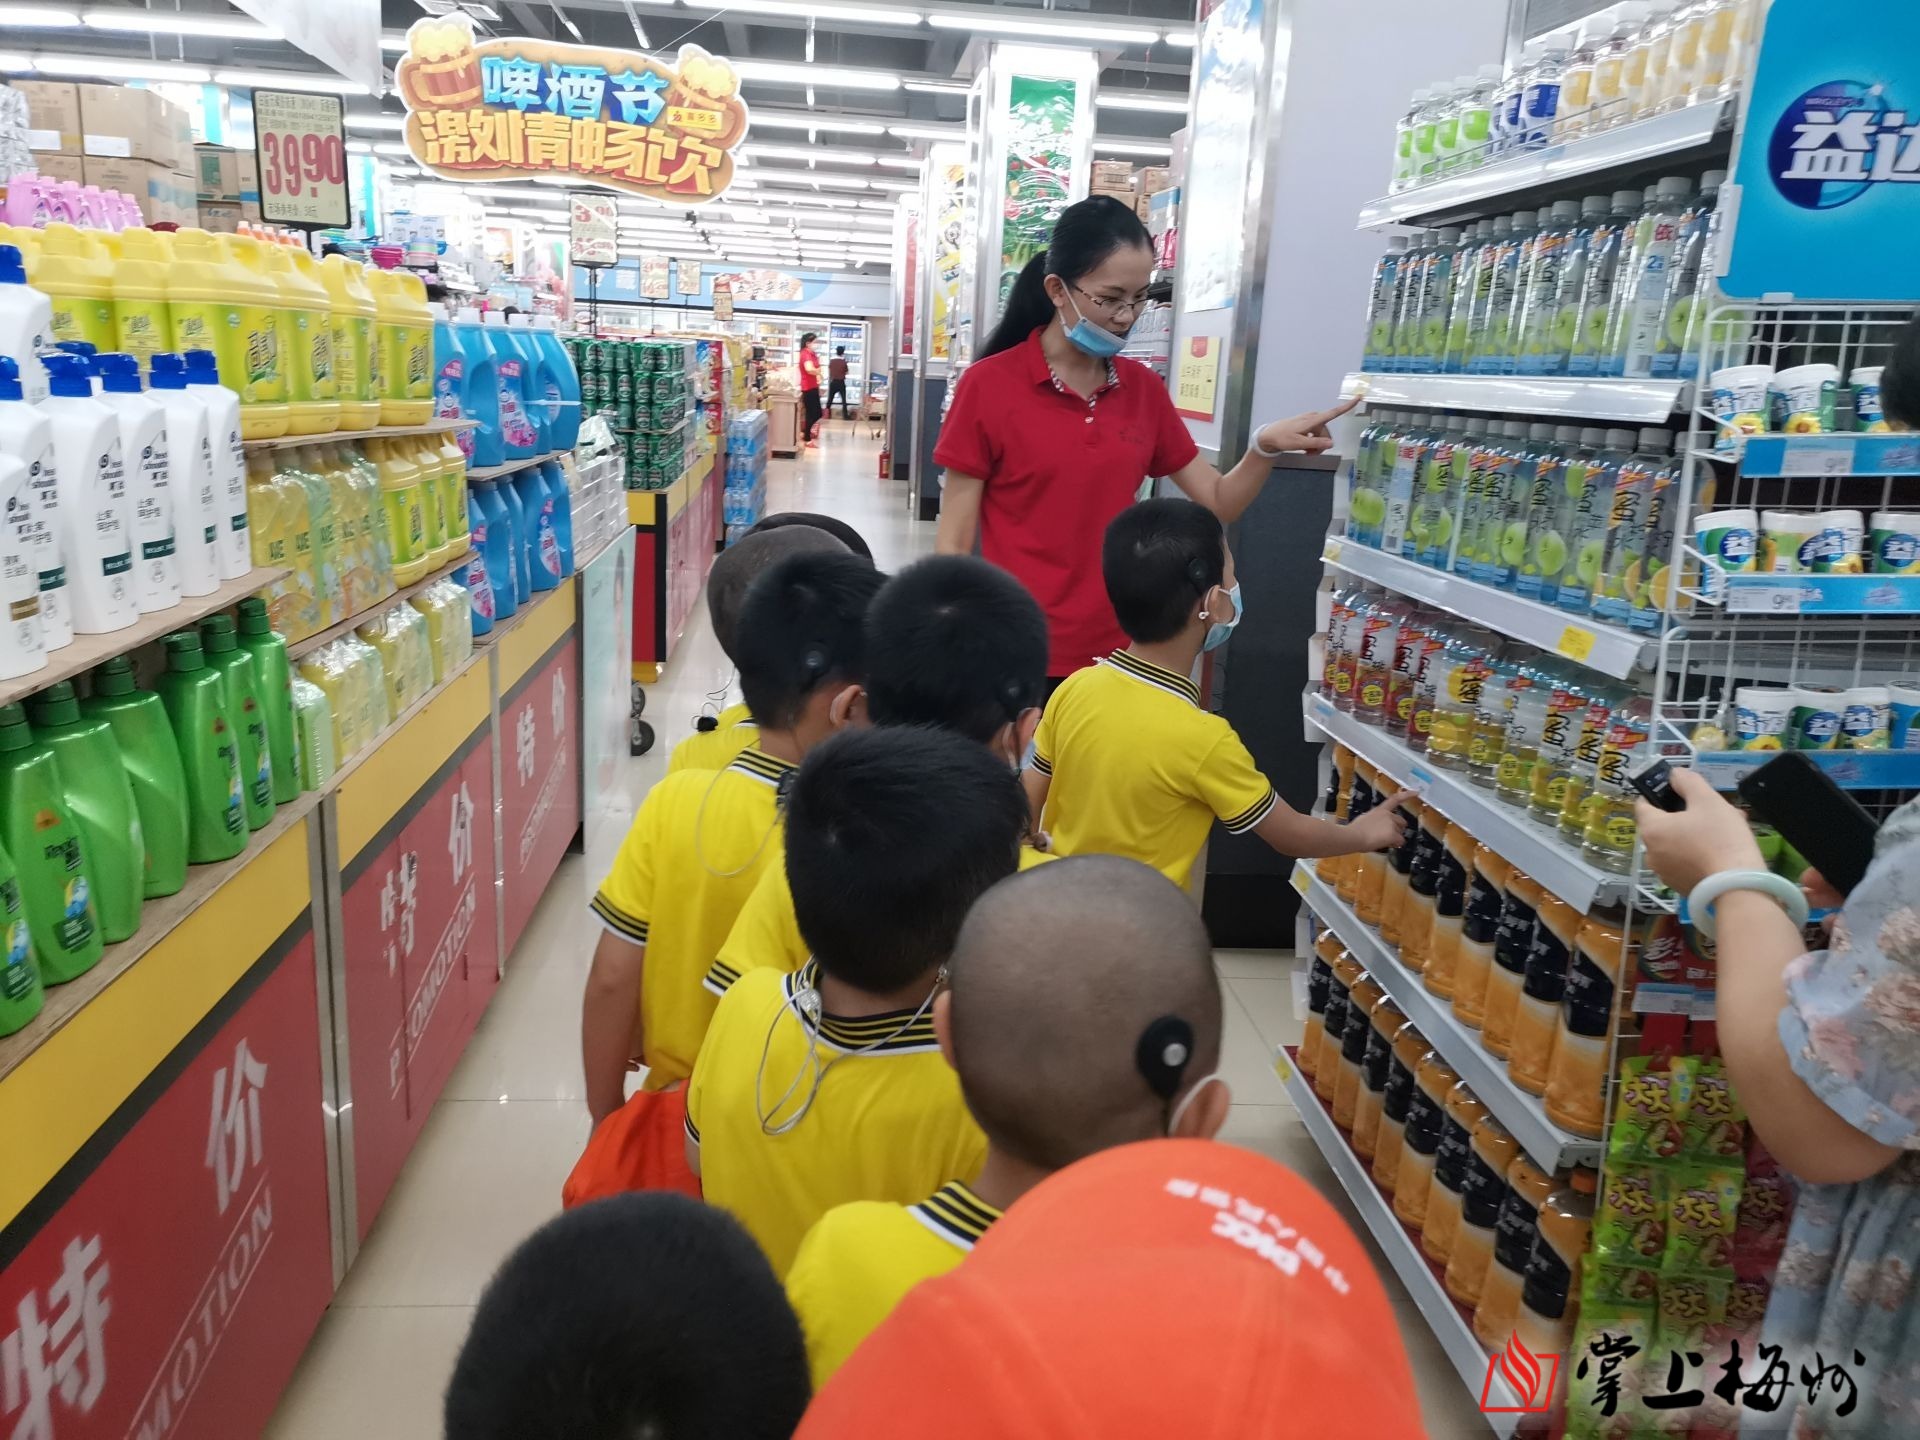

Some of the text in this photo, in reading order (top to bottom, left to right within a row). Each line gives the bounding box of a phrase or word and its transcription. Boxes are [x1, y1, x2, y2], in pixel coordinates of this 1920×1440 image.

[480, 56, 670, 125] 啤酒节
[416, 109, 723, 195] 激情畅饮
[389, 883, 477, 1090] POMOTION
